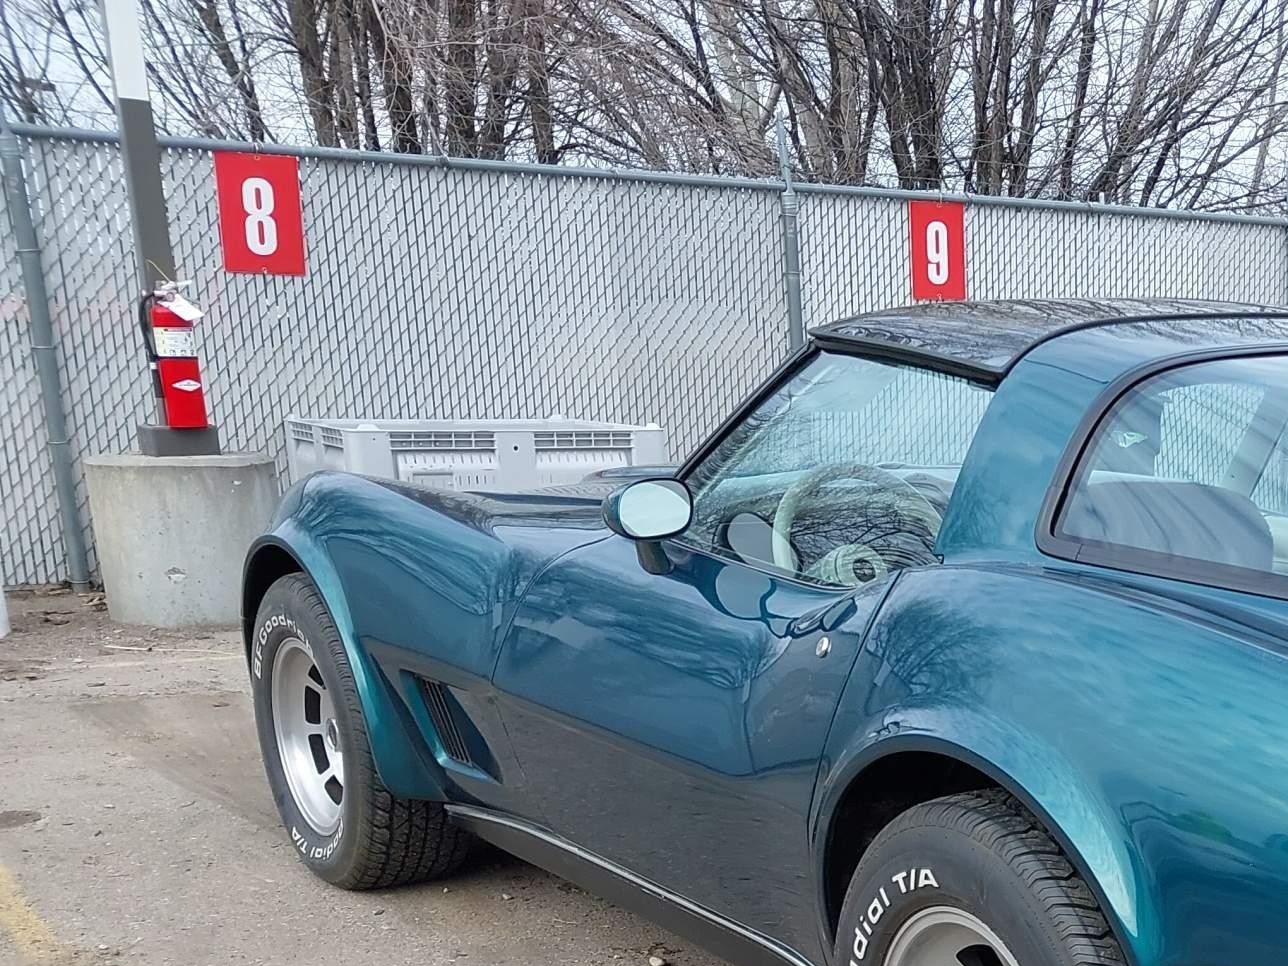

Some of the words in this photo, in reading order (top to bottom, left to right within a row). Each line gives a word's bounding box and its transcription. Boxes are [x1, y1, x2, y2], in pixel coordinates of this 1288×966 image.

[241, 177, 279, 256] 8
[926, 220, 950, 285] 9
[891, 868, 940, 894] T/A
